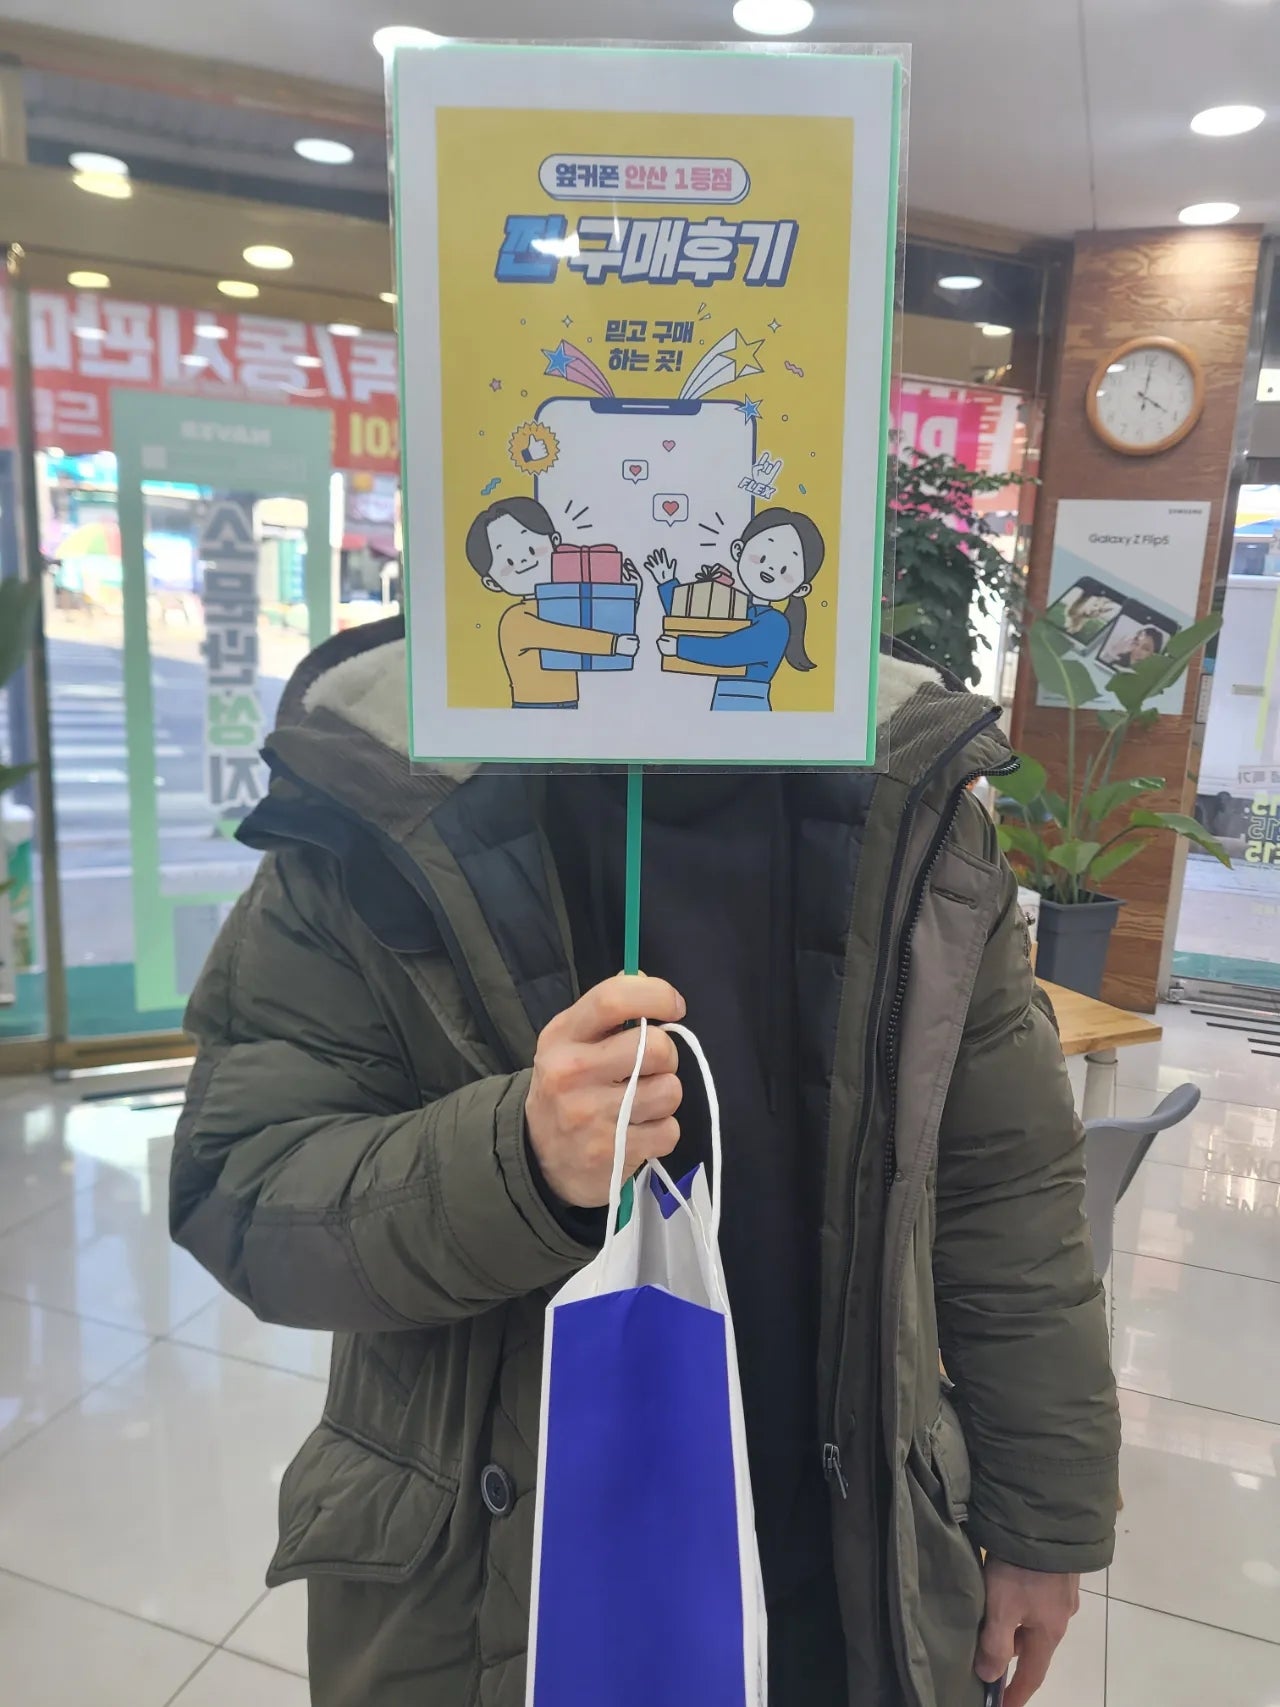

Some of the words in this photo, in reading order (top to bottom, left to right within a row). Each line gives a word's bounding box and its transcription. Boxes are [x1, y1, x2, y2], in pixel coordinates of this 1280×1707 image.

[555, 163, 620, 188] 옆커폰
[624, 165, 668, 190] 안산
[675, 167, 733, 192] 1등점
[567, 215, 799, 287] 구매후기
[605, 319, 648, 342] 믿고
[652, 321, 695, 344] 구매
[608, 347, 650, 371] 하는
[655, 349, 684, 372] 곳!
[738, 476, 777, 499] FLEX
[1088, 533, 1132, 546] Galaxy
[1132, 534, 1141, 545] Z
[1142, 534, 1170, 547] Flip5
